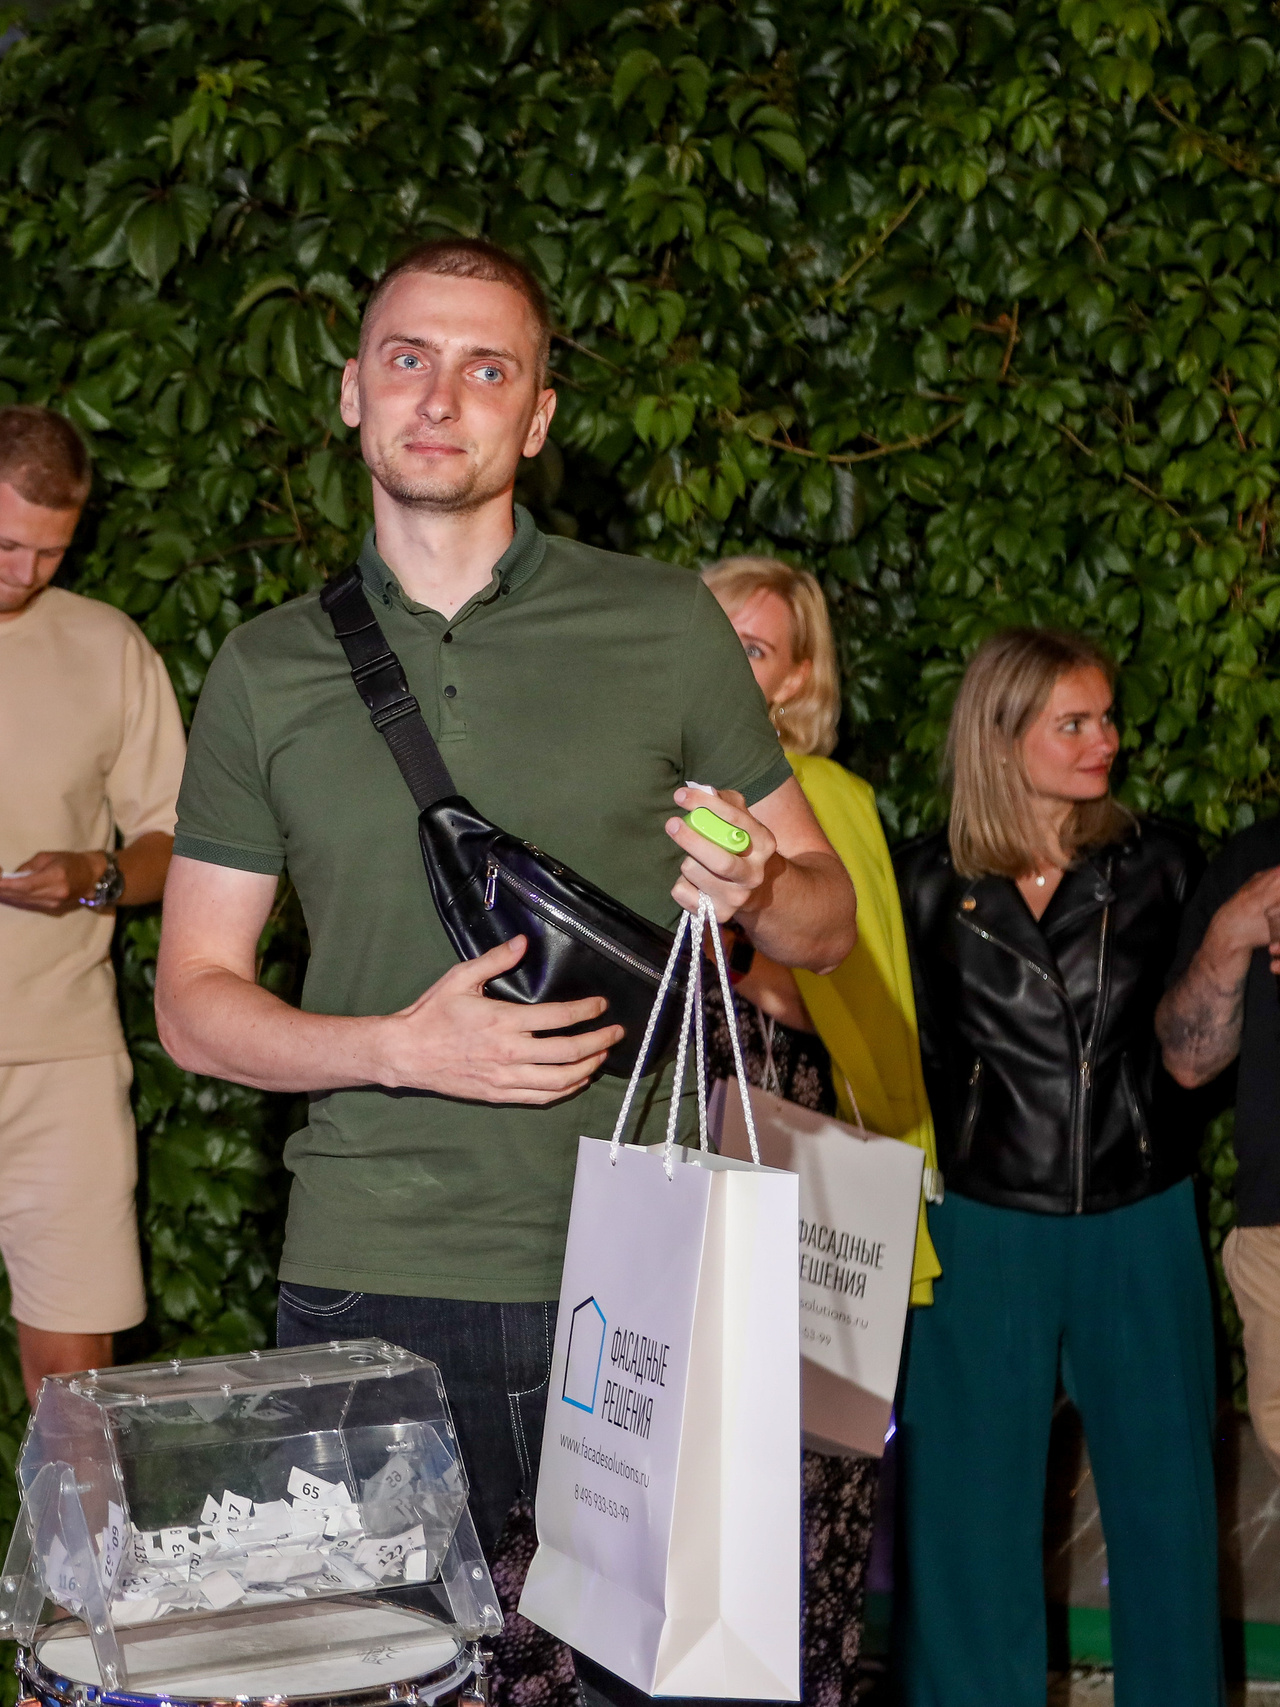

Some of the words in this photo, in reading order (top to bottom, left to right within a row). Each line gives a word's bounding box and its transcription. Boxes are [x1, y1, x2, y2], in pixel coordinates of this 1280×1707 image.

[800, 1253, 867, 1298] ЕШЕНИЯ
[610, 1326, 670, 1388] ФАСАДНЫЕ
[601, 1379, 654, 1440] РЕШЕНИЯ
[560, 1432, 650, 1488] www.facadesolutions.ru
[302, 1482, 320, 1499] 65
[574, 1484, 580, 1500] 8
[580, 1486, 593, 1507] 495
[593, 1493, 630, 1523] 933-53-99
